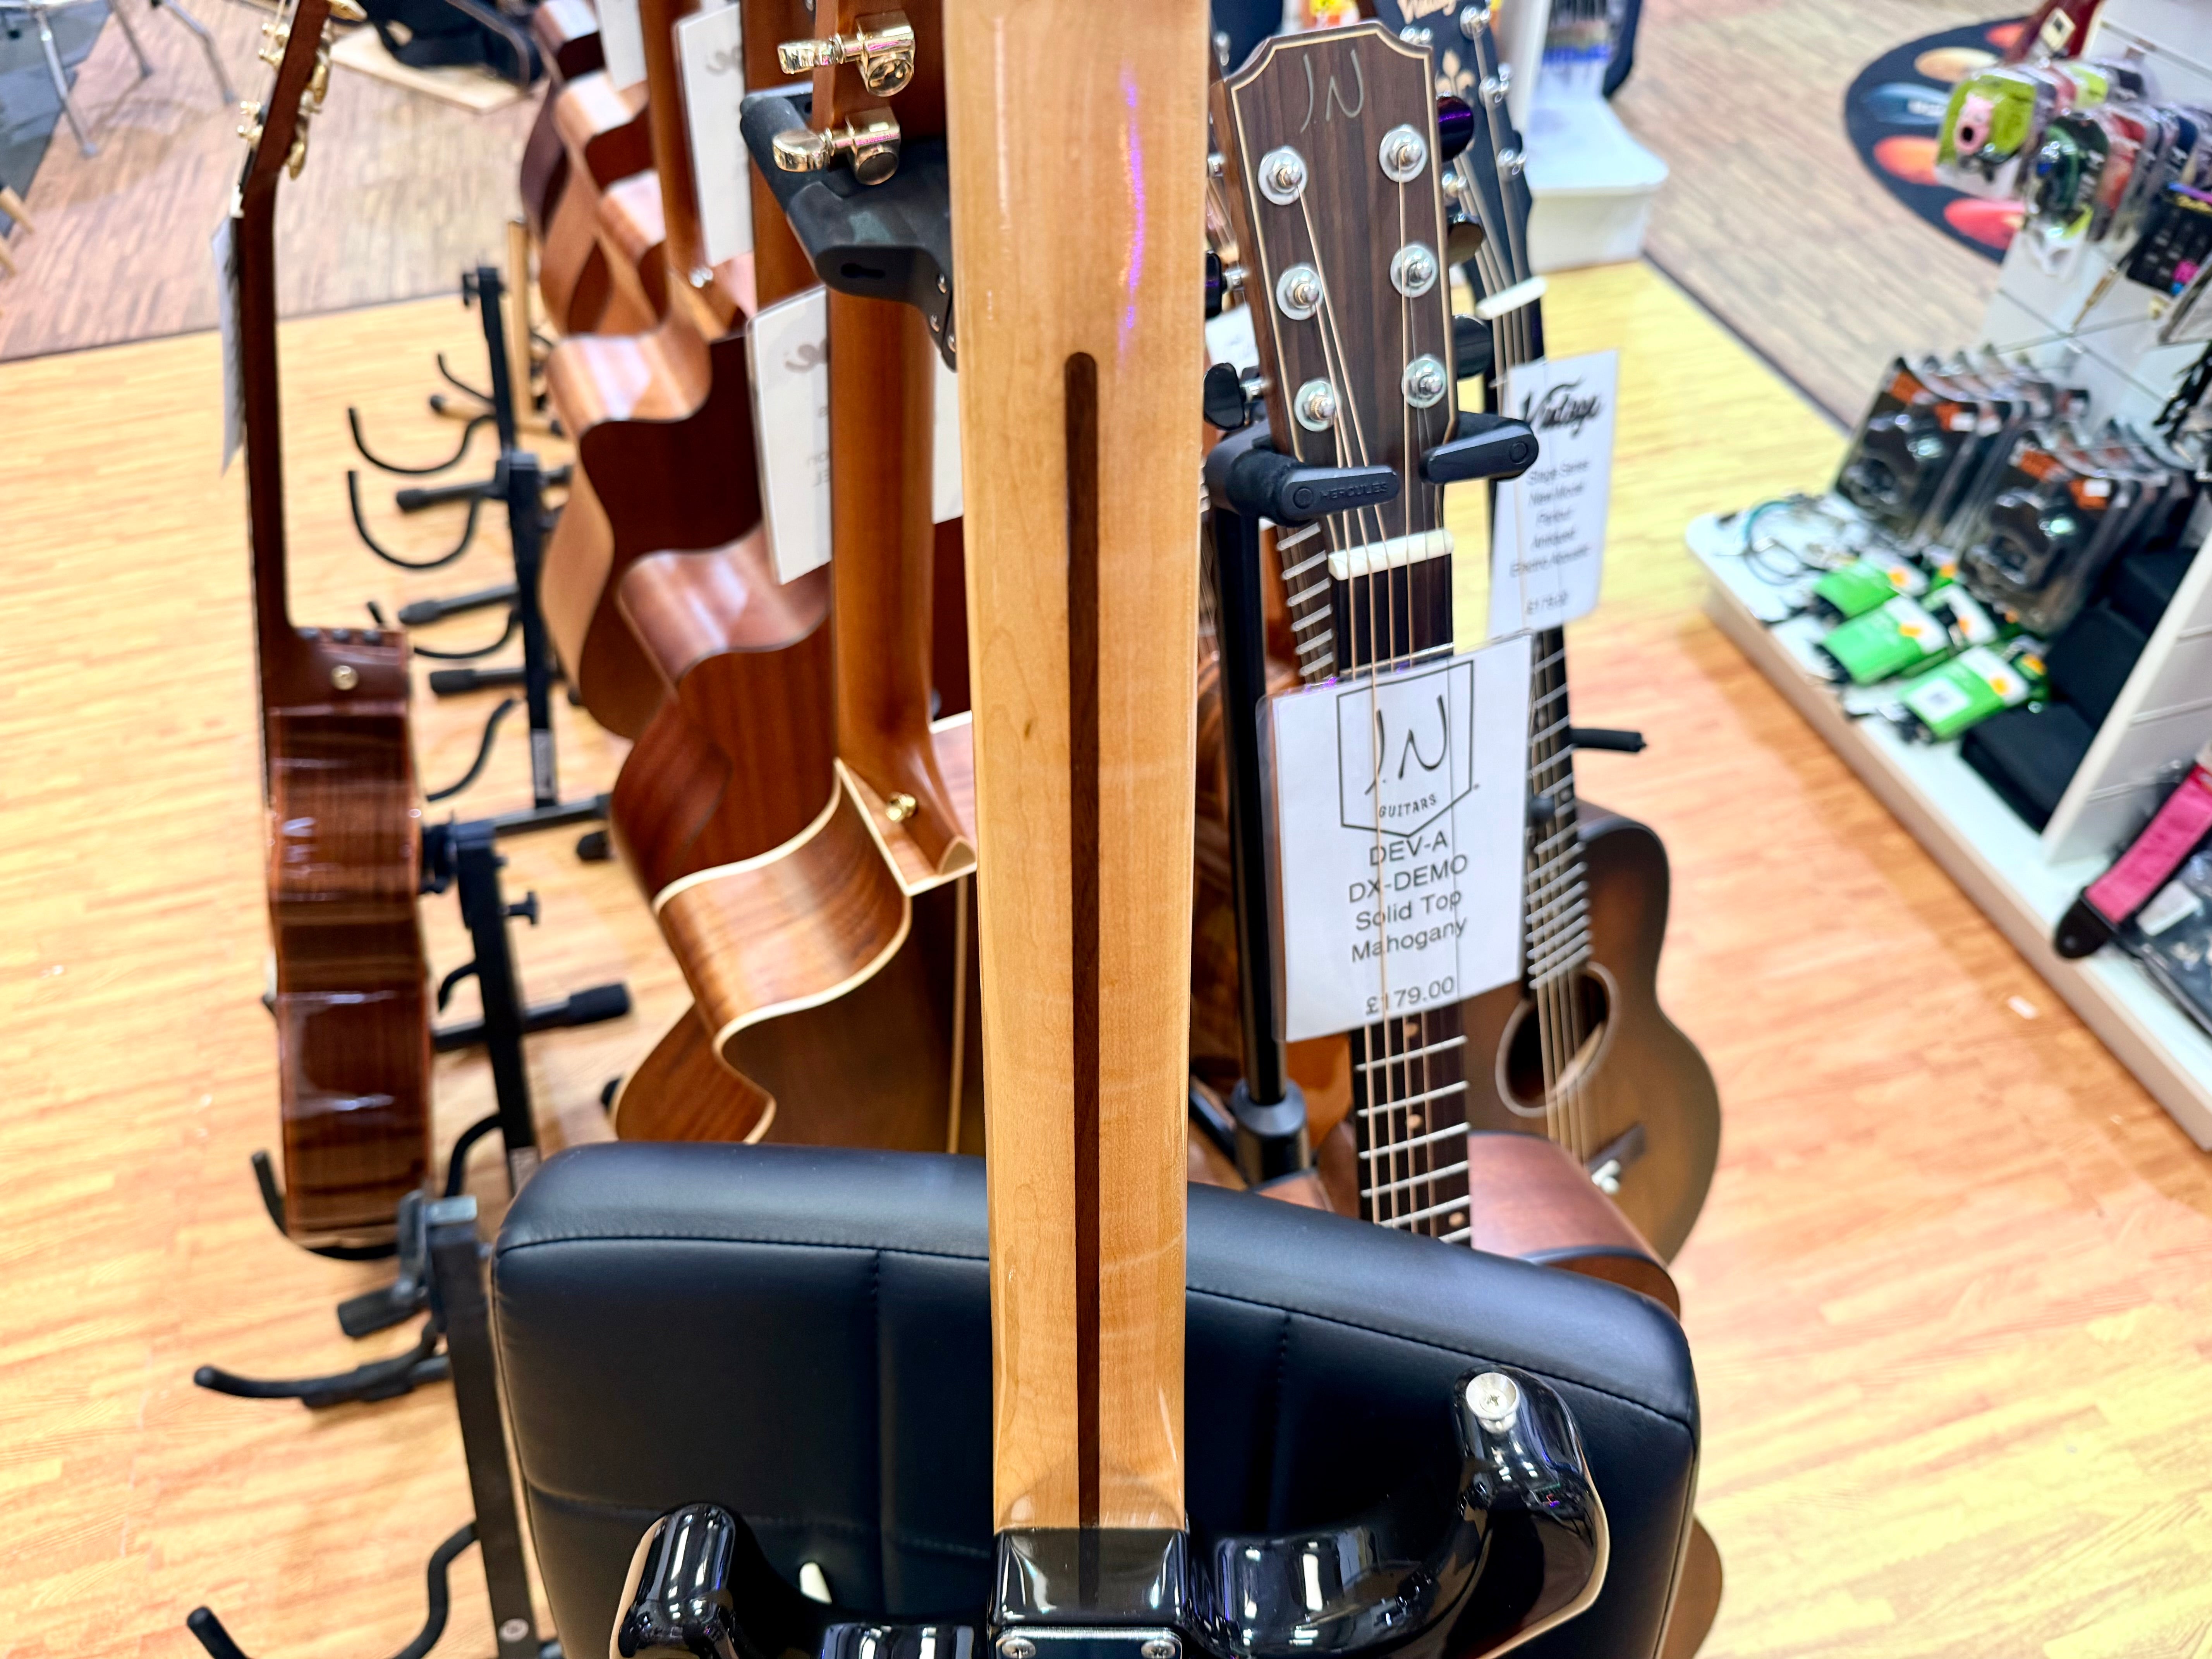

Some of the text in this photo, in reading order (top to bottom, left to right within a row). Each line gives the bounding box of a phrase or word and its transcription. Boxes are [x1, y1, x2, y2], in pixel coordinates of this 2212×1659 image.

[1379, 793, 1437, 818] GUITARS
[1370, 831, 1448, 866] DEV-A
[1349, 854, 1468, 903] DX-DEMO
[1356, 891, 1462, 930] Solid Top
[1352, 917, 1467, 963] Mahogany
[1366, 976, 1455, 1016] £179.00
